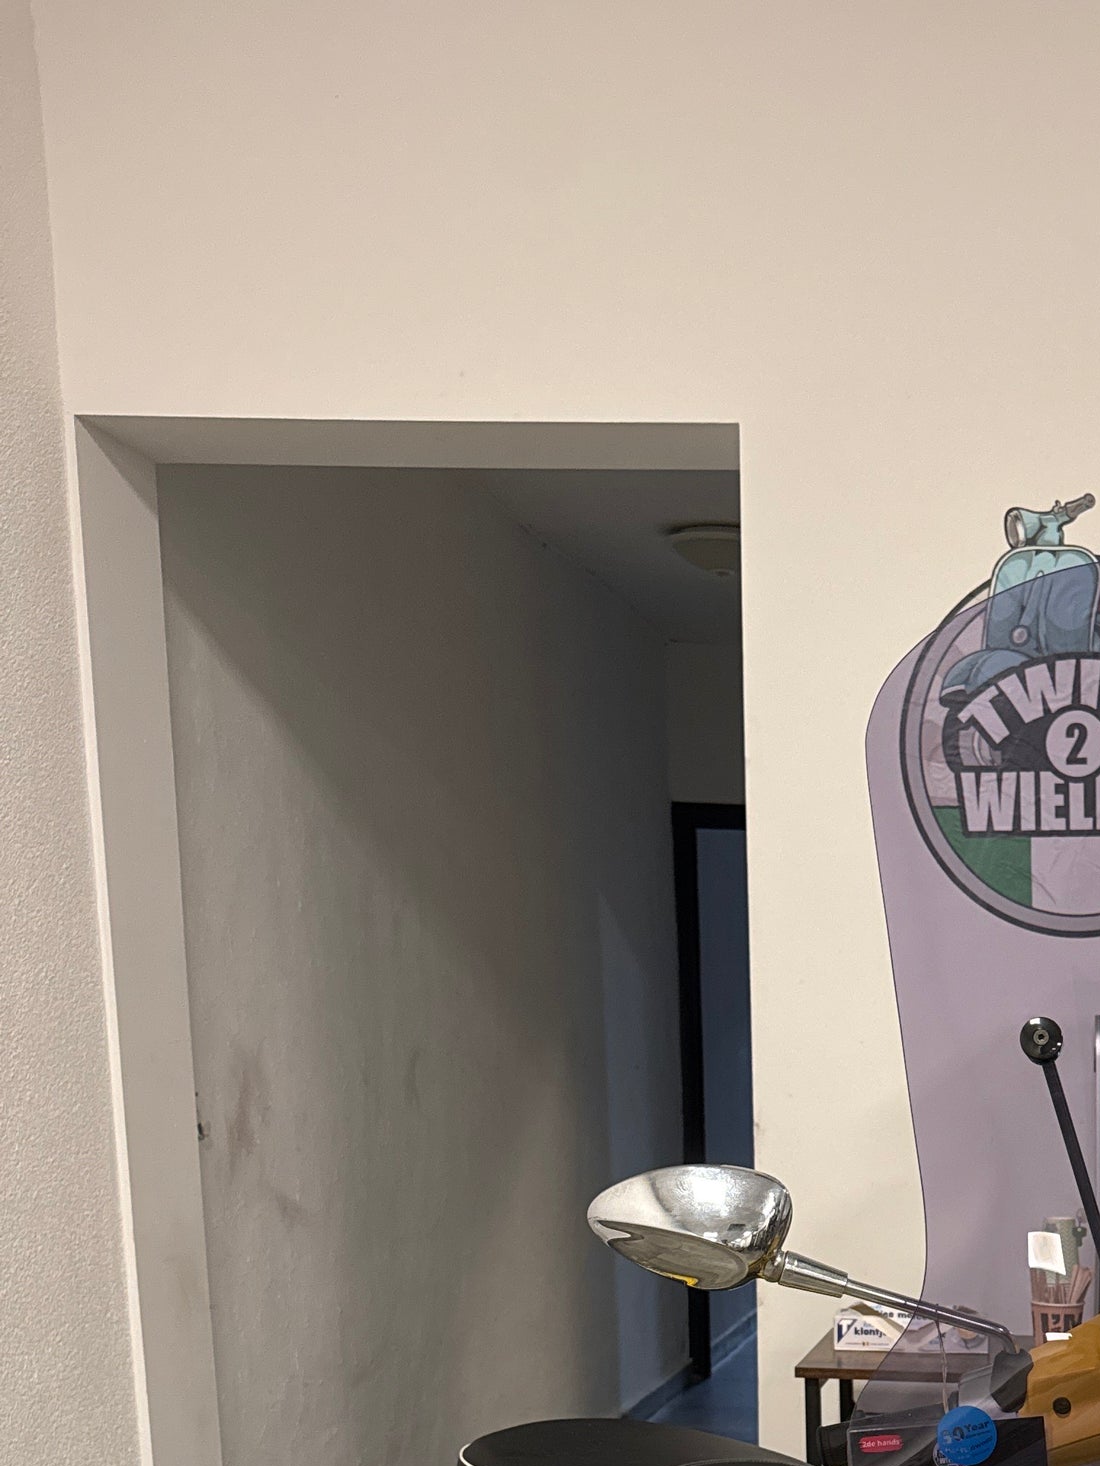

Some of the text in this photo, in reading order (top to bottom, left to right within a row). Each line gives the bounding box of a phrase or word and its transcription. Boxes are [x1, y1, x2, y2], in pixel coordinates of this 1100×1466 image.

[1063, 722, 1088, 765] 2
[862, 1438, 901, 1449] 2de hands
